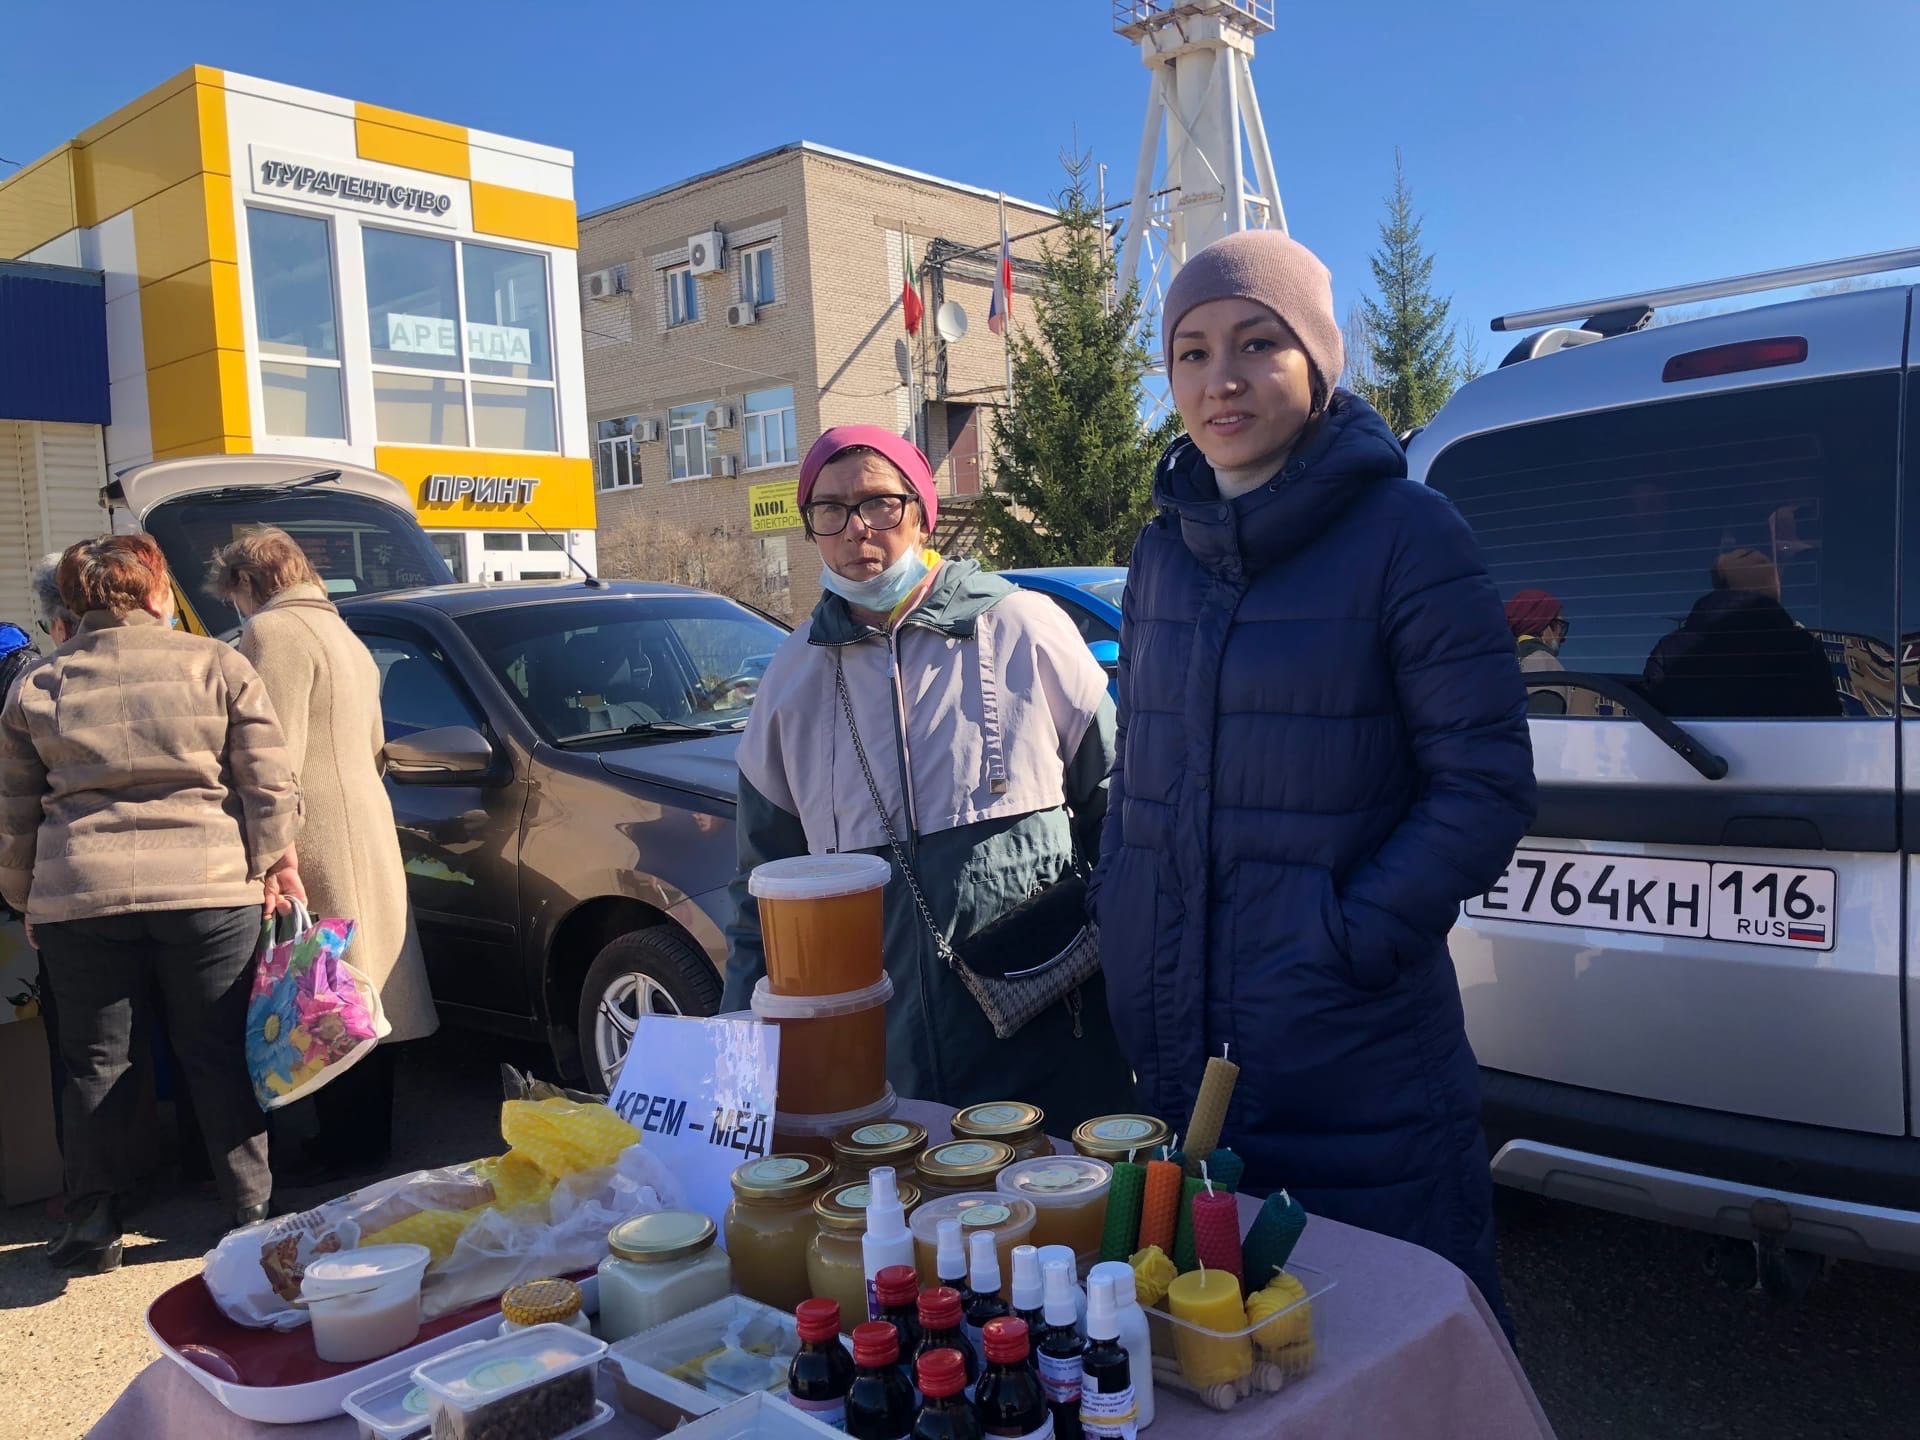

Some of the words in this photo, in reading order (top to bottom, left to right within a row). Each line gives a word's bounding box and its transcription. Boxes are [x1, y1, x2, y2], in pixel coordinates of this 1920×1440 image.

[265, 160, 451, 214] ТУРАГЕНТСТВО
[391, 321, 529, 359] АРЕНДА
[426, 474, 540, 504] ПРИНТ
[1718, 871, 1815, 919] 116
[1737, 918, 1785, 938] RUS
[615, 1090, 687, 1136] КРЕМ
[709, 1101, 768, 1159] МЁД
